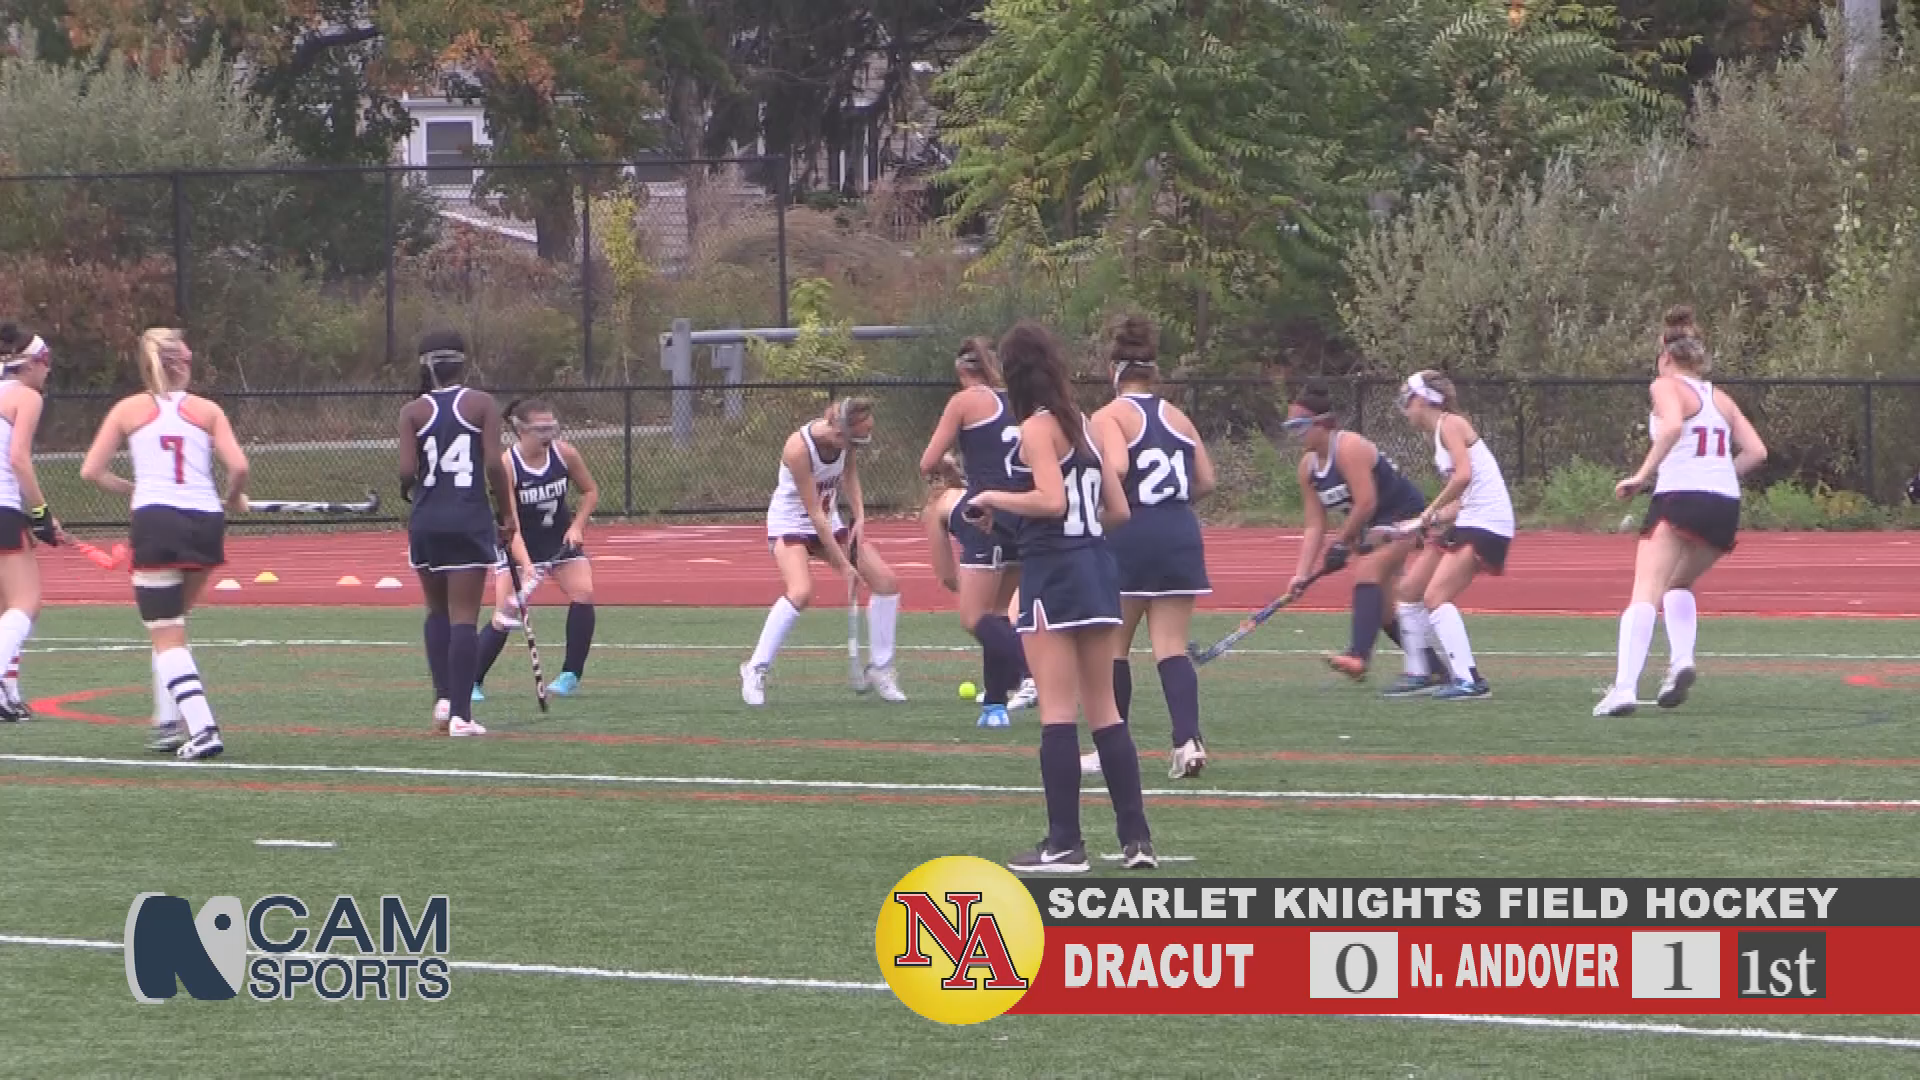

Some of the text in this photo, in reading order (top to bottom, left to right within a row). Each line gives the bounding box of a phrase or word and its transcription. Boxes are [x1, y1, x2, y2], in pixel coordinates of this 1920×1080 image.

[160, 436, 185, 484] 7
[422, 434, 474, 486] 14
[1691, 427, 1727, 457] 11
[519, 479, 568, 503] DRACUT
[1137, 448, 1190, 504] 21
[537, 502, 559, 527] 7
[1063, 468, 1103, 537] 10
